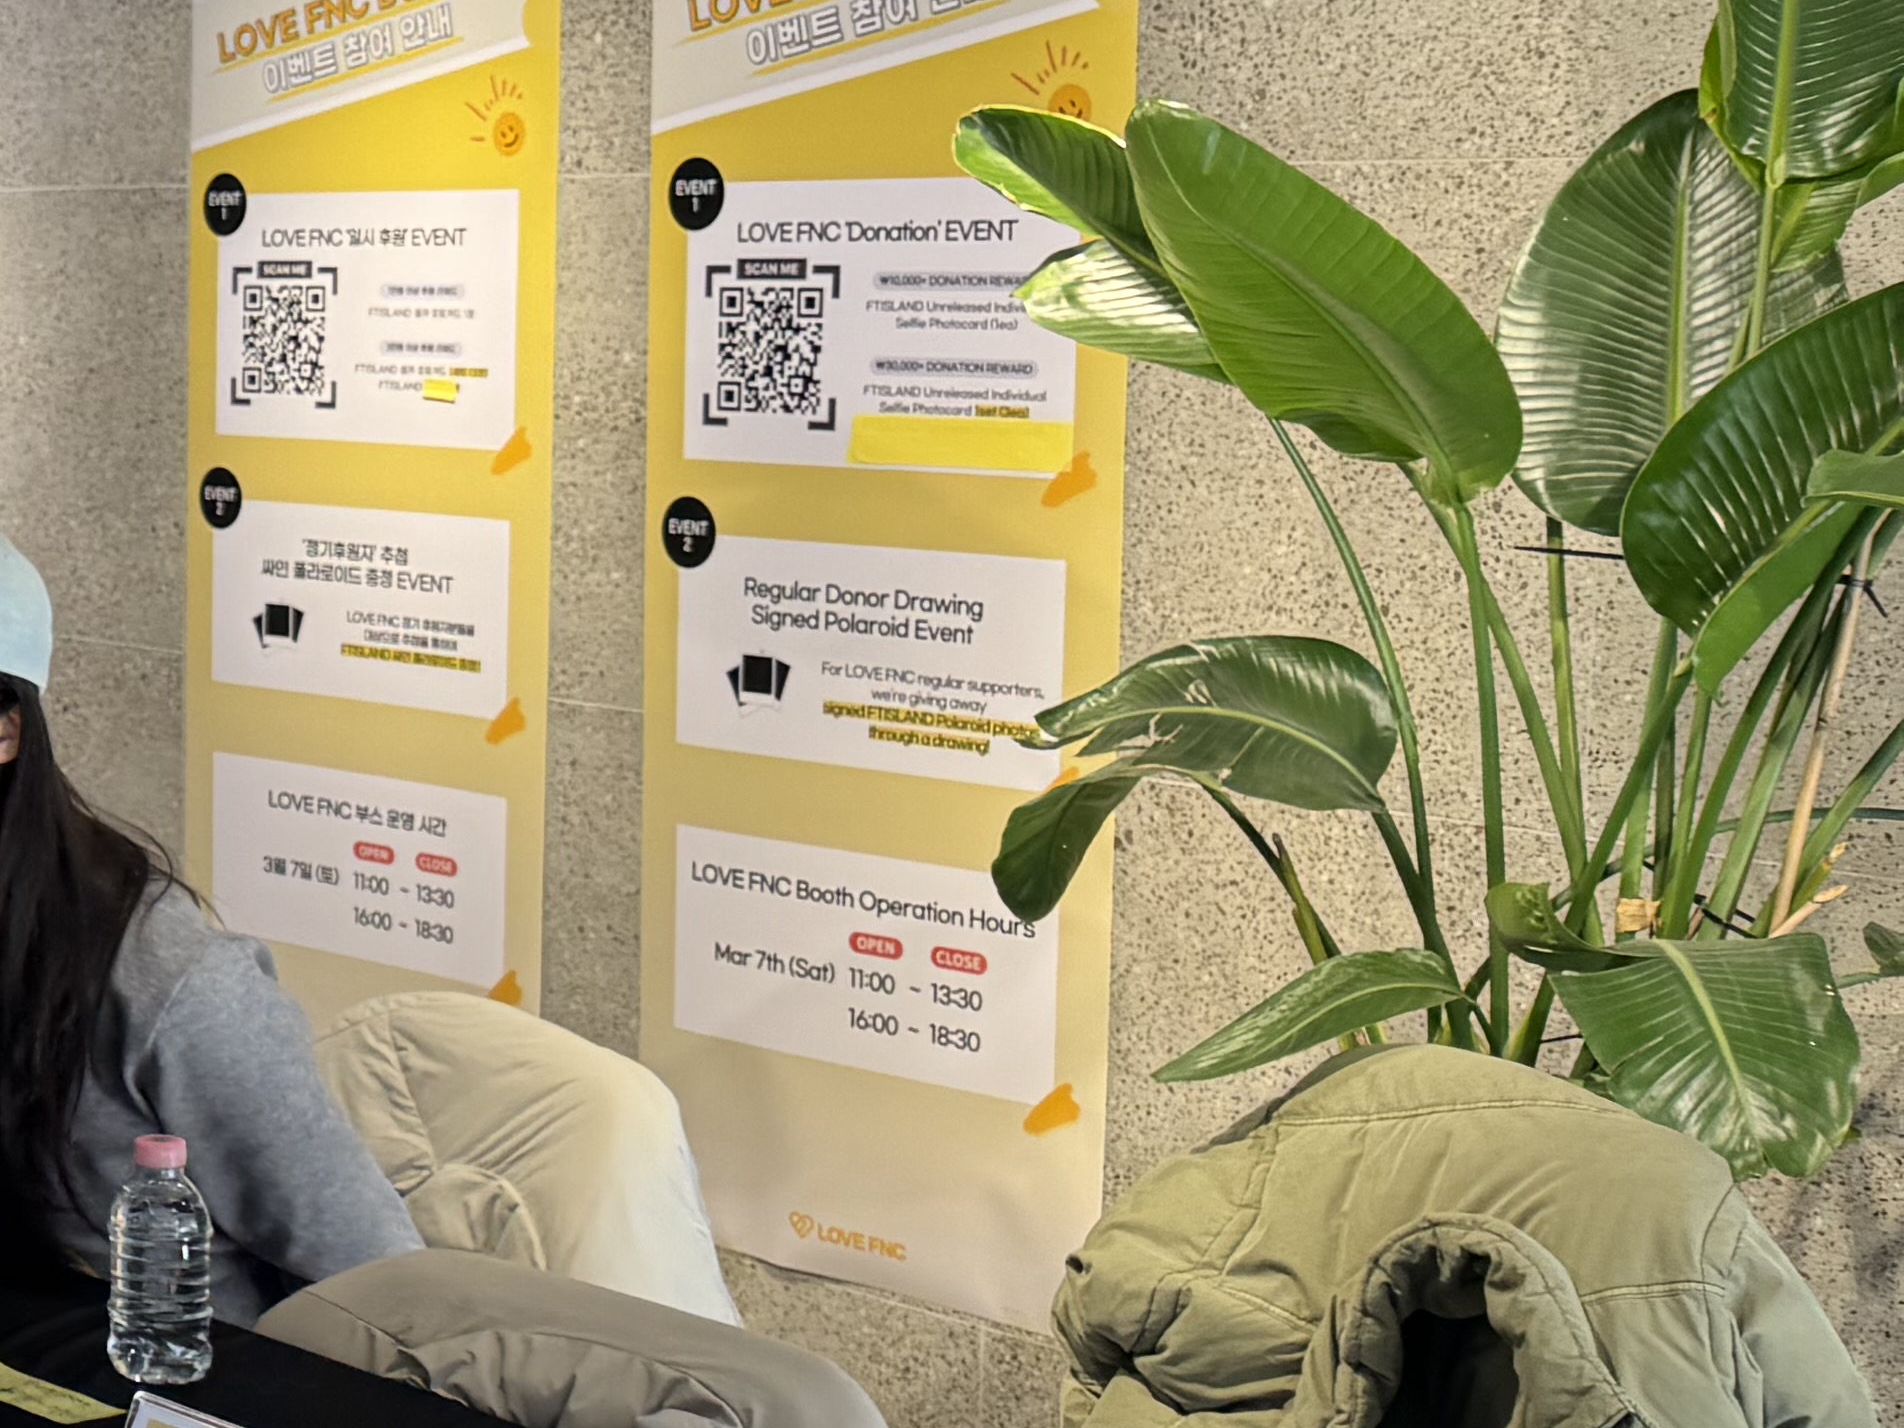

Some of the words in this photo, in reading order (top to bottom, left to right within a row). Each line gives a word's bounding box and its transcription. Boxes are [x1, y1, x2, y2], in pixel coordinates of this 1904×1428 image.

[216, 9, 300, 64] LOVE
[264, 43, 337, 93] 이벤트
[343, 27, 393, 67] 참여
[399, 4, 452, 48] 안내
[746, 9, 843, 65] 이벤트
[676, 179, 717, 197] EVENT
[262, 228, 307, 247] LOVE
[309, 228, 343, 247] FNC
[412, 228, 467, 247] EVENT
[737, 221, 792, 243] LOVE
[796, 221, 840, 243] FNC
[945, 219, 1019, 242] EVENT
[669, 518, 708, 537] EVENT
[397, 572, 454, 595] EVENT
[744, 577, 821, 606] Regular
[826, 584, 889, 609] Donor
[894, 589, 984, 622] Drawing
[752, 605, 819, 633] Signed
[825, 610, 909, 639] Polaroid
[915, 620, 974, 645] Event
[821, 662, 843, 677] For
[845, 663, 885, 682] LOVE
[885, 668, 915, 685] FNC
[918, 673, 965, 692] regular
[907, 692, 947, 713] giving
[949, 699, 988, 715] away
[268, 790, 314, 814] LOVE
[316, 797, 352, 819] FNC
[355, 804, 382, 826] 부스
[387, 809, 414, 831] 운영
[419, 816, 447, 837] 시간
[263, 855, 287, 876] 3월
[291, 859, 312, 881] 7일
[316, 864, 339, 886] (토)
[353, 871, 389, 895] 11:00
[415, 883, 454, 909] 13:30
[692, 861, 744, 889] LOVE
[748, 872, 791, 896] FNC
[796, 880, 854, 907] Booth
[859, 891, 963, 927] Operation
[970, 908, 1036, 939] Hours
[353, 906, 392, 931] 16:00
[415, 918, 453, 944] 18:30
[856, 936, 896, 955] OPEN
[935, 950, 982, 972] CLOSE
[715, 942, 752, 966] Mar
[755, 950, 784, 973] 7th
[790, 957, 835, 985] (Sat)
[849, 967, 896, 995] 11:00
[931, 983, 983, 1012] 13:30
[848, 1008, 899, 1036] 16:00
[930, 1023, 980, 1052] 18:30
[817, 1223, 866, 1251] LOVE
[868, 1236, 907, 1261] FNC
